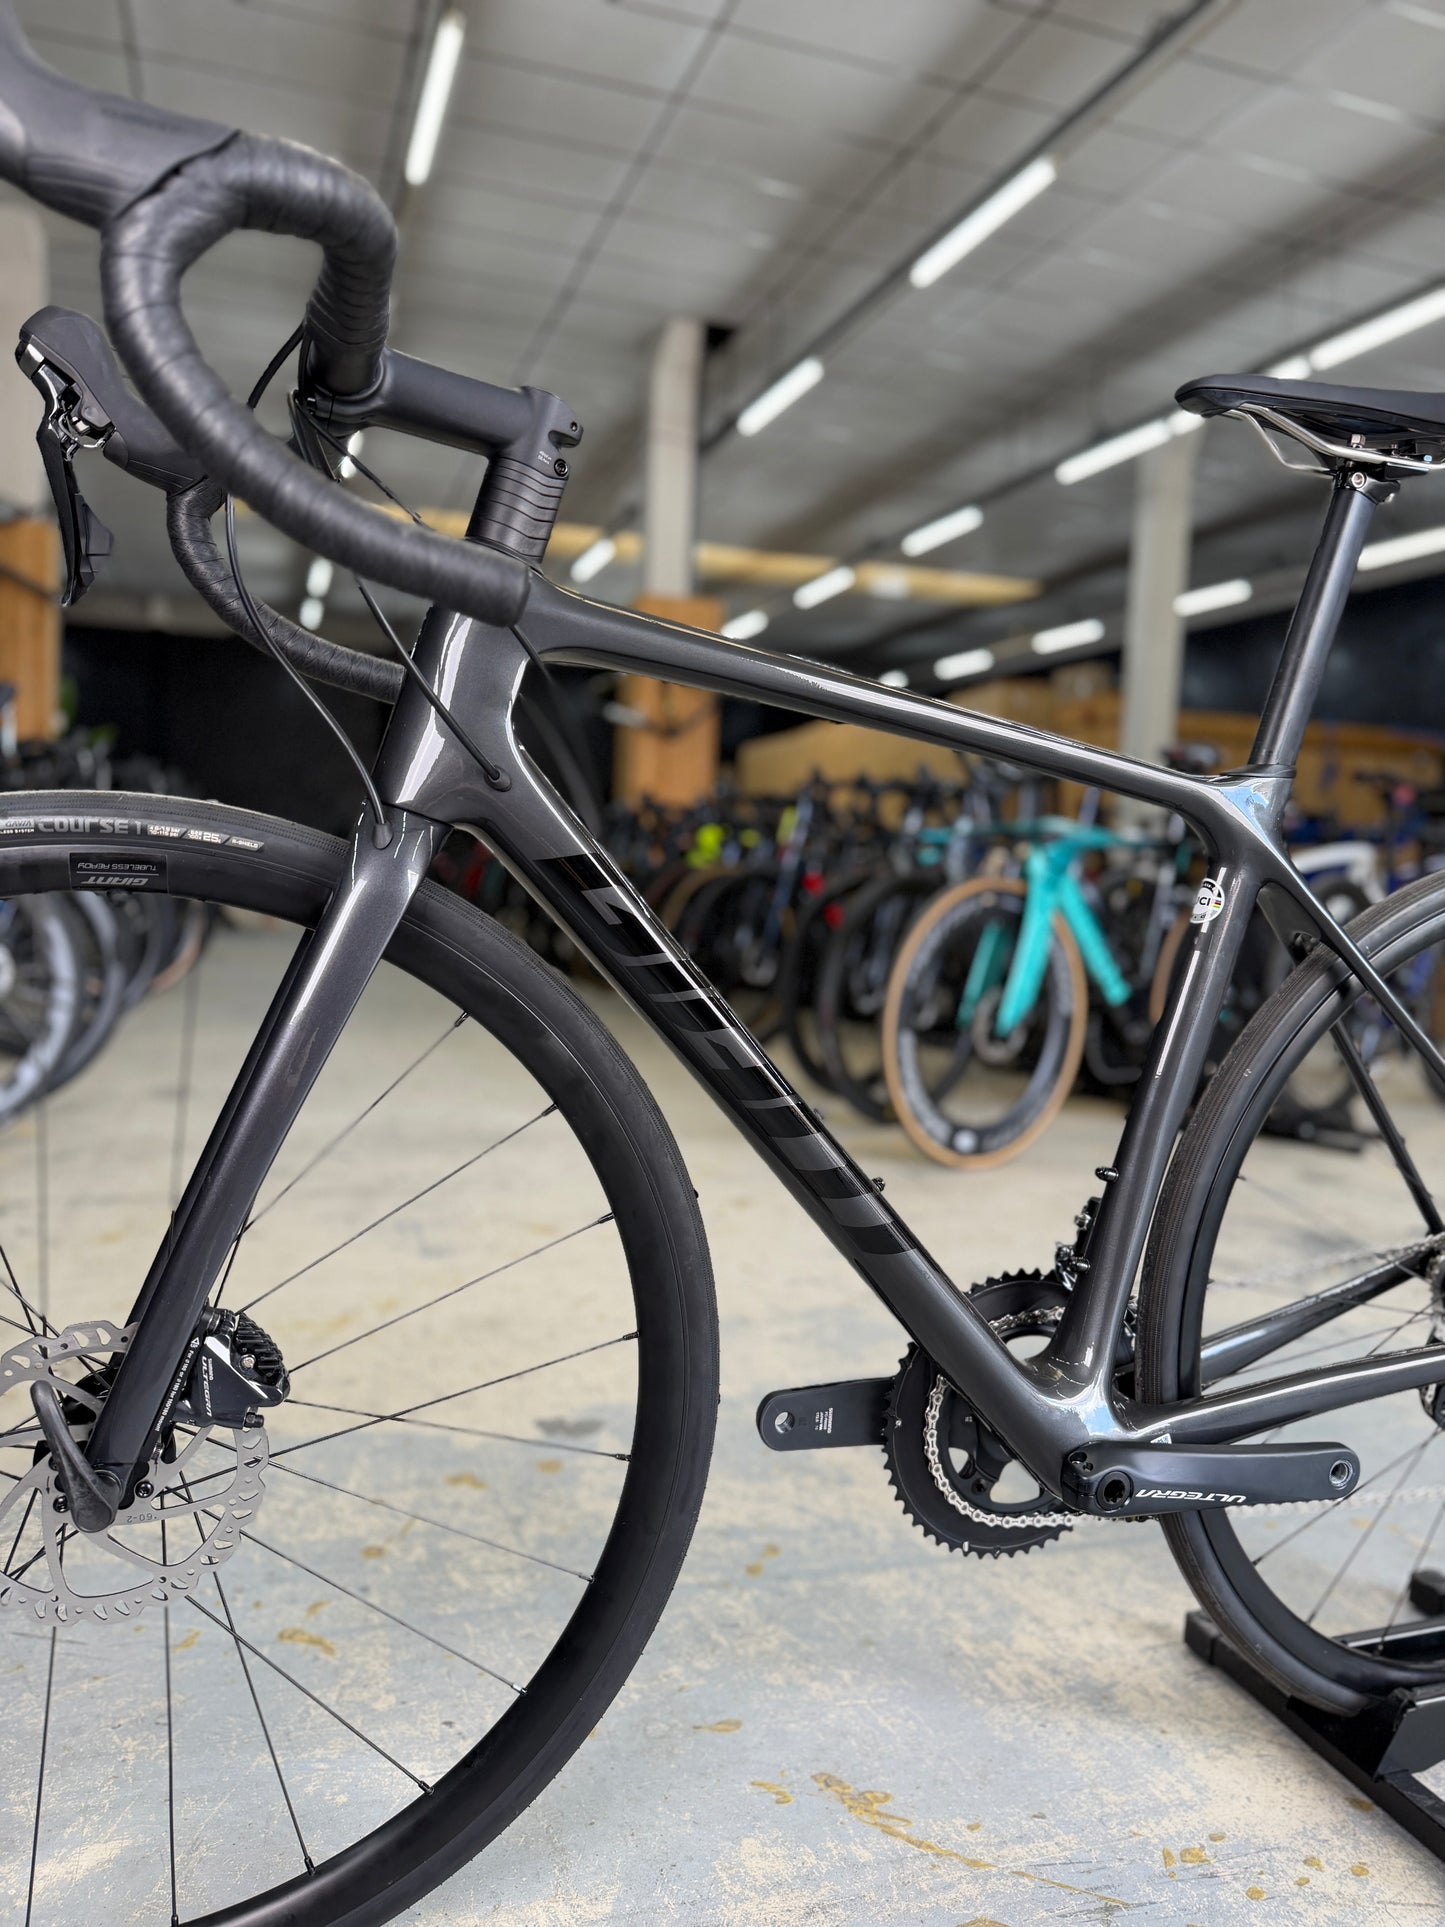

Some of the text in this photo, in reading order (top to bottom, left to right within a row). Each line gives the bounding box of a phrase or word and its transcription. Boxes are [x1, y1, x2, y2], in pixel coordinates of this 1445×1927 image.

[38, 817, 129, 834] COURSE
[135, 821, 142, 835] 1
[77, 861, 157, 871] TUBELESS READY
[80, 876, 149, 886] GIANT
[202, 1355, 212, 1417] ULTEGRA
[1135, 1489, 1246, 1503] ULTEGRA
